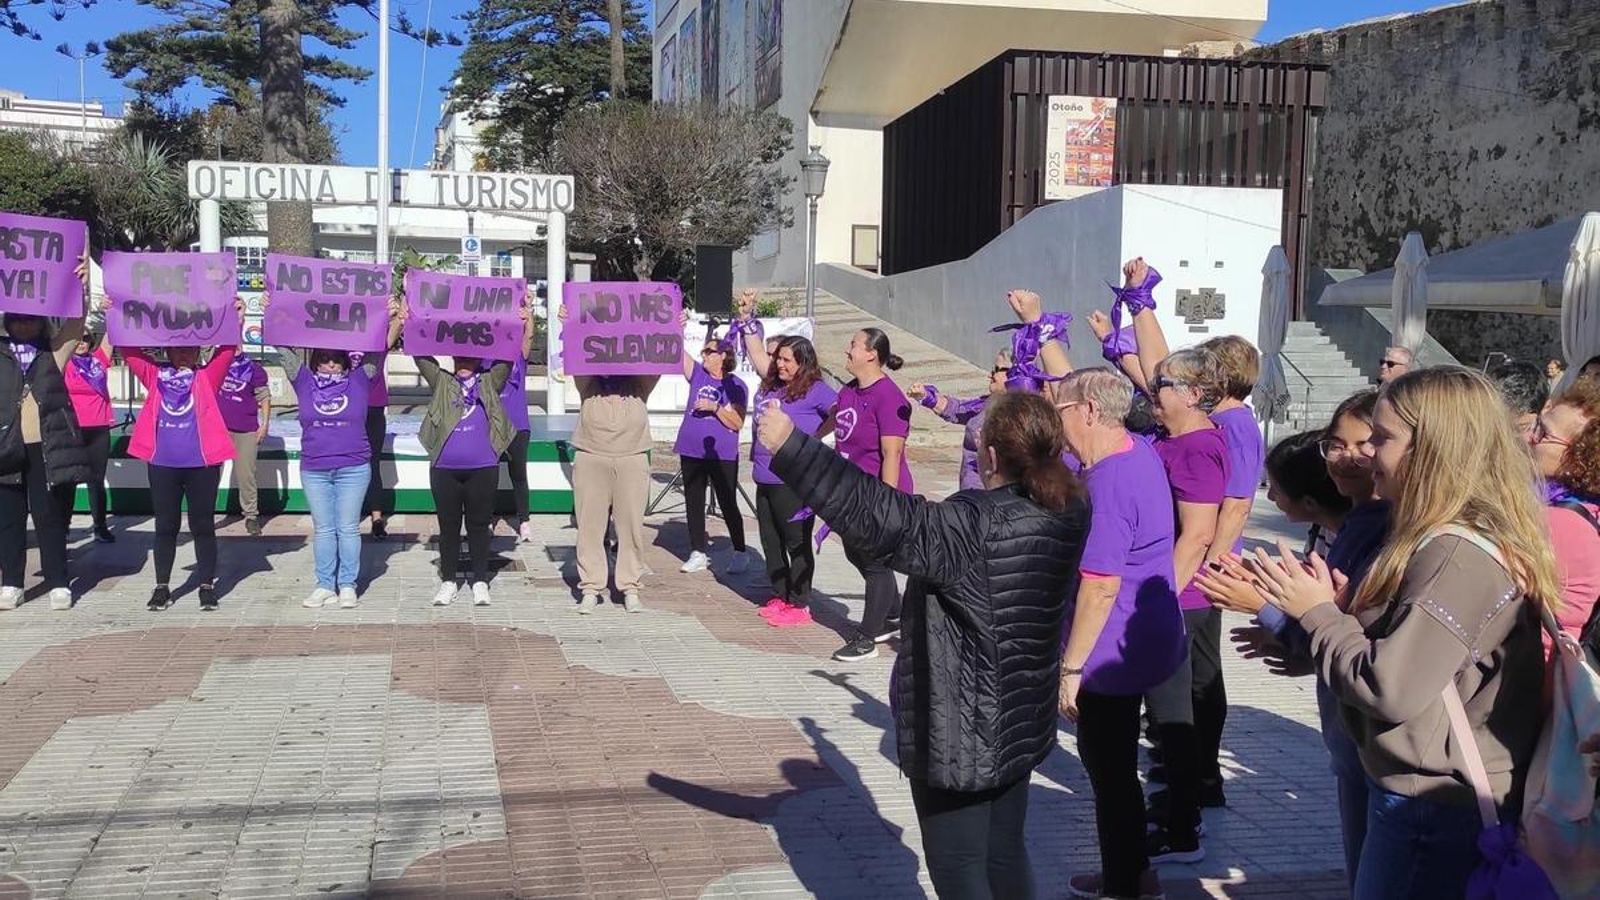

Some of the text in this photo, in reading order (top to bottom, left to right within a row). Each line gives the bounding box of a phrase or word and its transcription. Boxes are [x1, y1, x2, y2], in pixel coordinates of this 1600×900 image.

[1052, 103, 1083, 112] Otoño
[1049, 152, 1060, 186] 2025
[195, 165, 337, 202] OFICINA
[431, 173, 573, 211] TURISMO
[0, 269, 48, 304] YA!
[276, 263, 313, 293] NO
[463, 285, 513, 312] UNA
[579, 291, 622, 323] NO
[304, 300, 367, 333] SOLA
